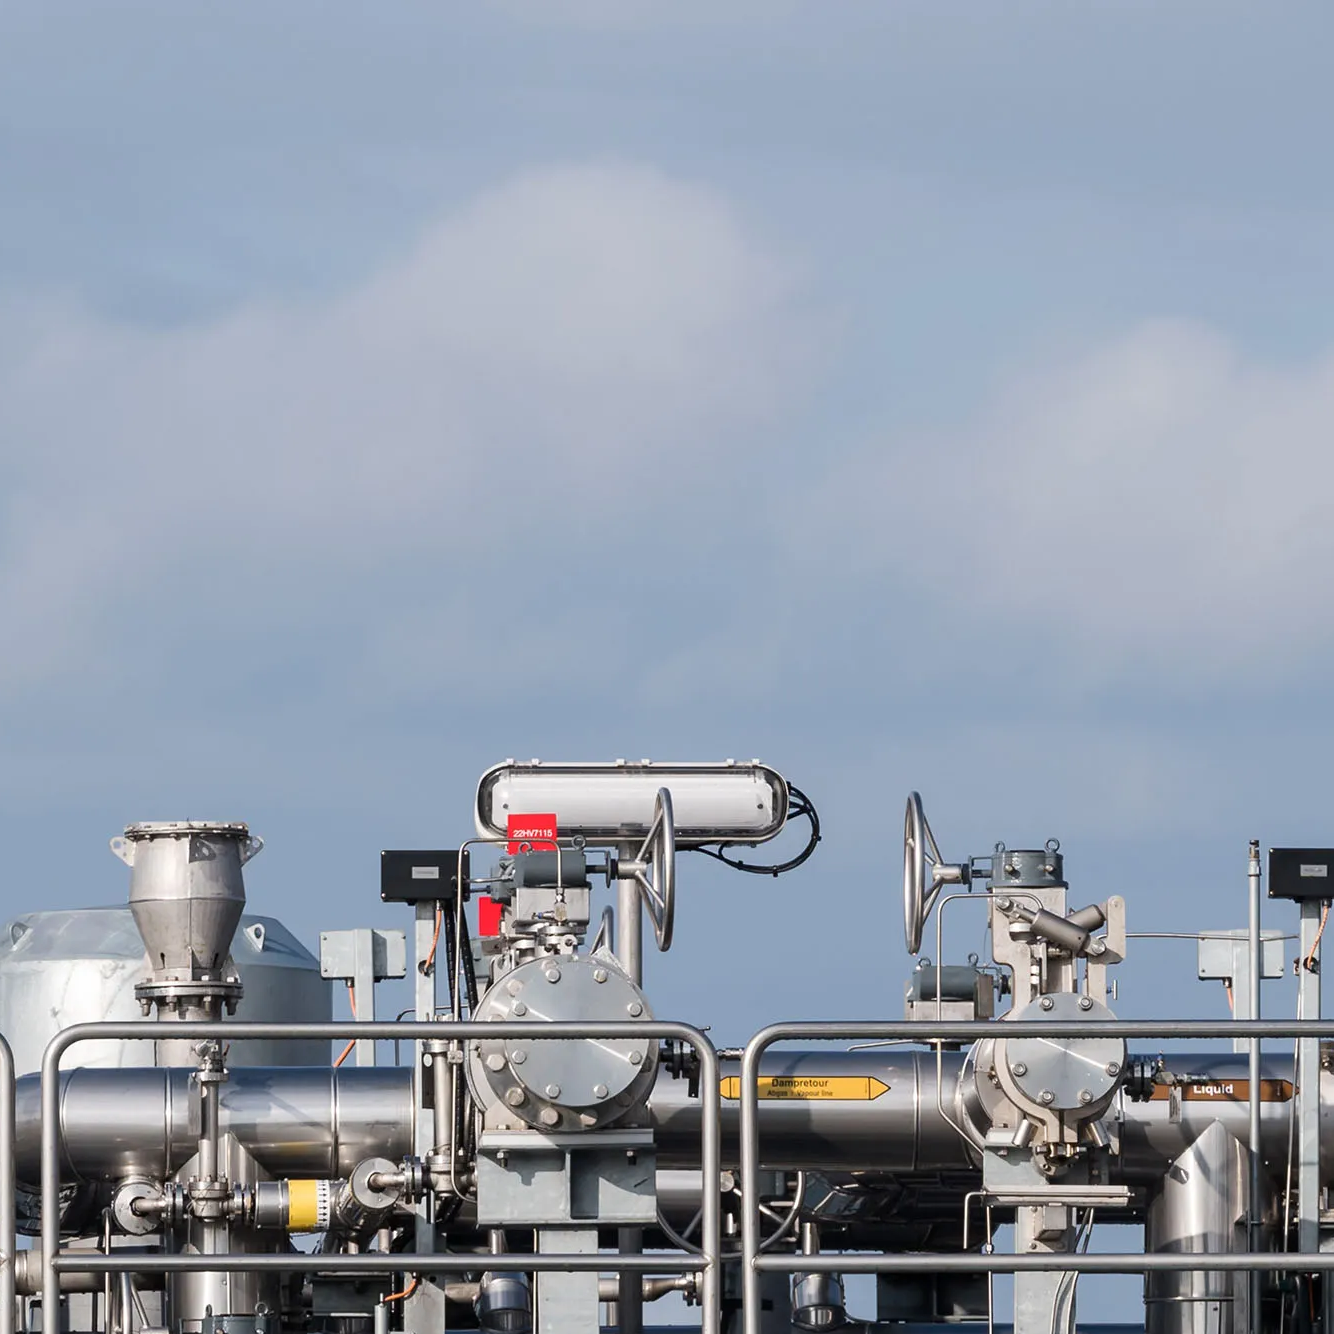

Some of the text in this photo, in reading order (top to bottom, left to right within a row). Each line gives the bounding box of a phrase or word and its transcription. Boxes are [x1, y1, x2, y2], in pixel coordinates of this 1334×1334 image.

[513, 829, 553, 838] 22HV7115
[771, 1078, 828, 1088] Dampretour
[1193, 1084, 1234, 1096] Liquid
